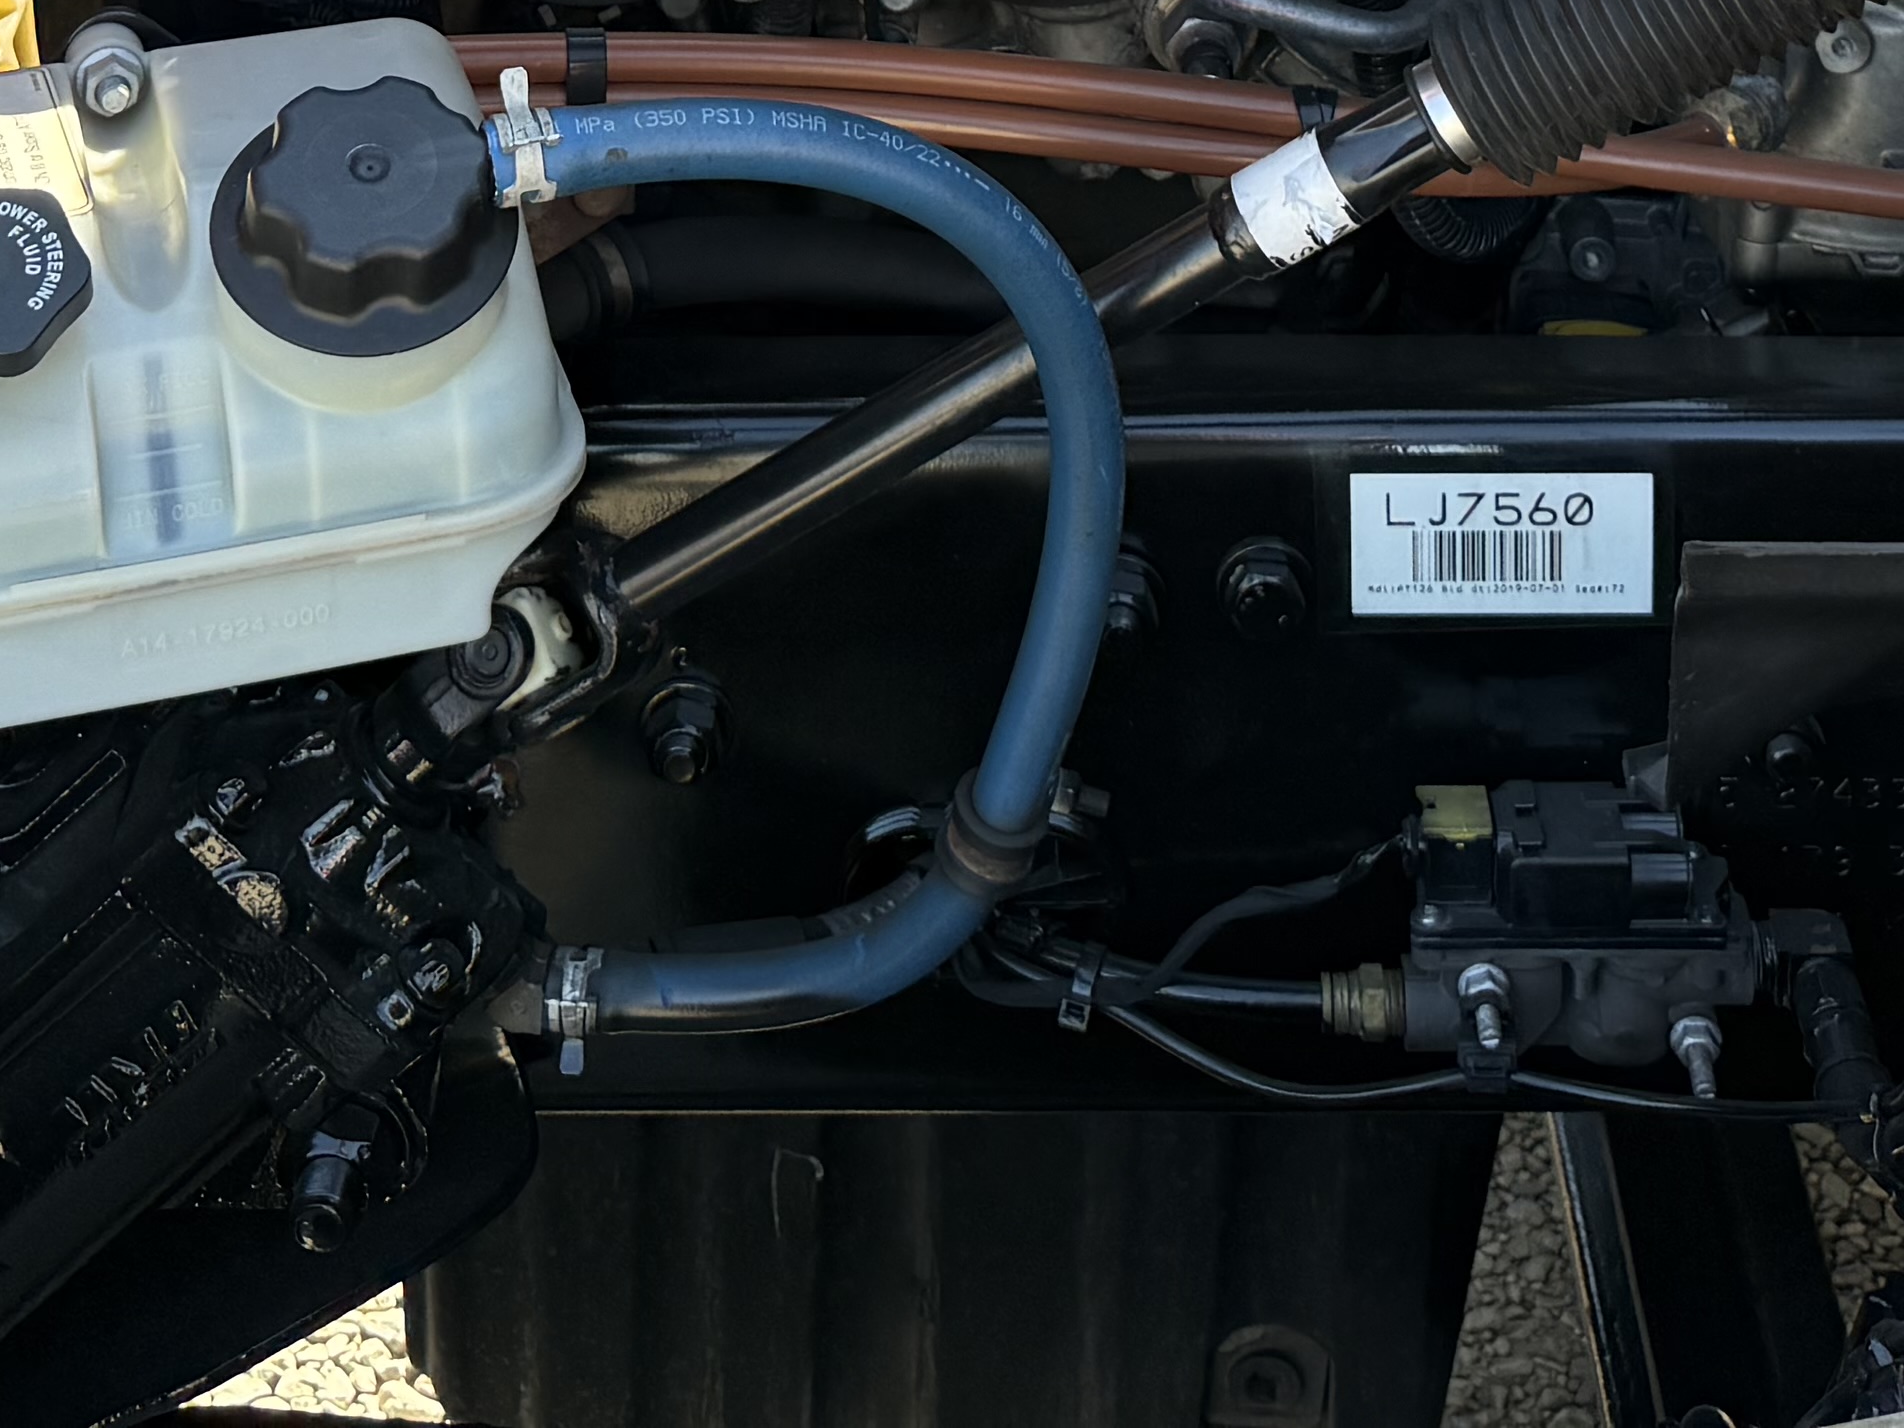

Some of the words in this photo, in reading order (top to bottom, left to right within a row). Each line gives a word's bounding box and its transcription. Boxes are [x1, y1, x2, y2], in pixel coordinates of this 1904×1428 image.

[576, 117, 615, 135] MPa
[633, 109, 687, 130] (350
[702, 107, 756, 126] PSI)
[772, 110, 827, 134] MSHA
[1005, 196, 1024, 222] 16
[7, 224, 42, 276] FLUID
[27, 231, 64, 311] STEERING
[1386, 491, 1594, 526] LJ7560
